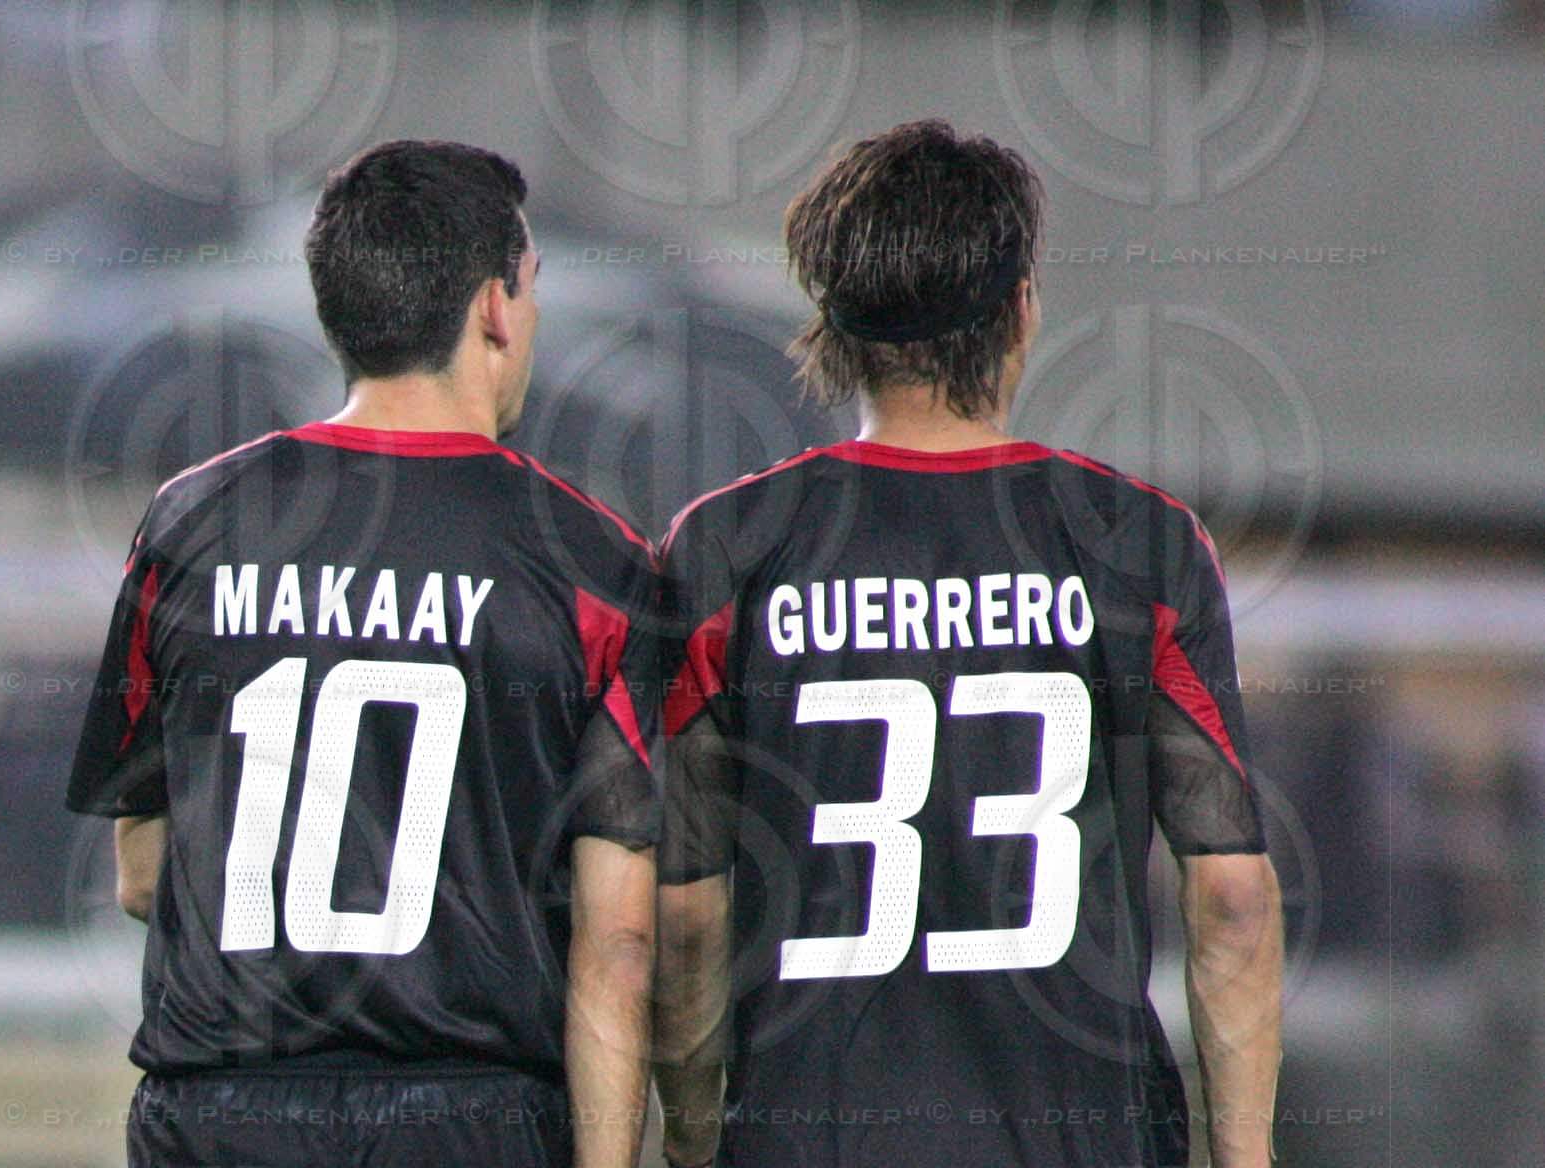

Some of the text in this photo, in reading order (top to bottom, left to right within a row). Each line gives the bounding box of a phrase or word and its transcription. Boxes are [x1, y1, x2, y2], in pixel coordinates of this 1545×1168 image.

[214, 563, 494, 646] MAKAAY
[767, 573, 1095, 656] GUERRERO
[220, 657, 467, 955] 10
[779, 671, 1092, 980] 33
